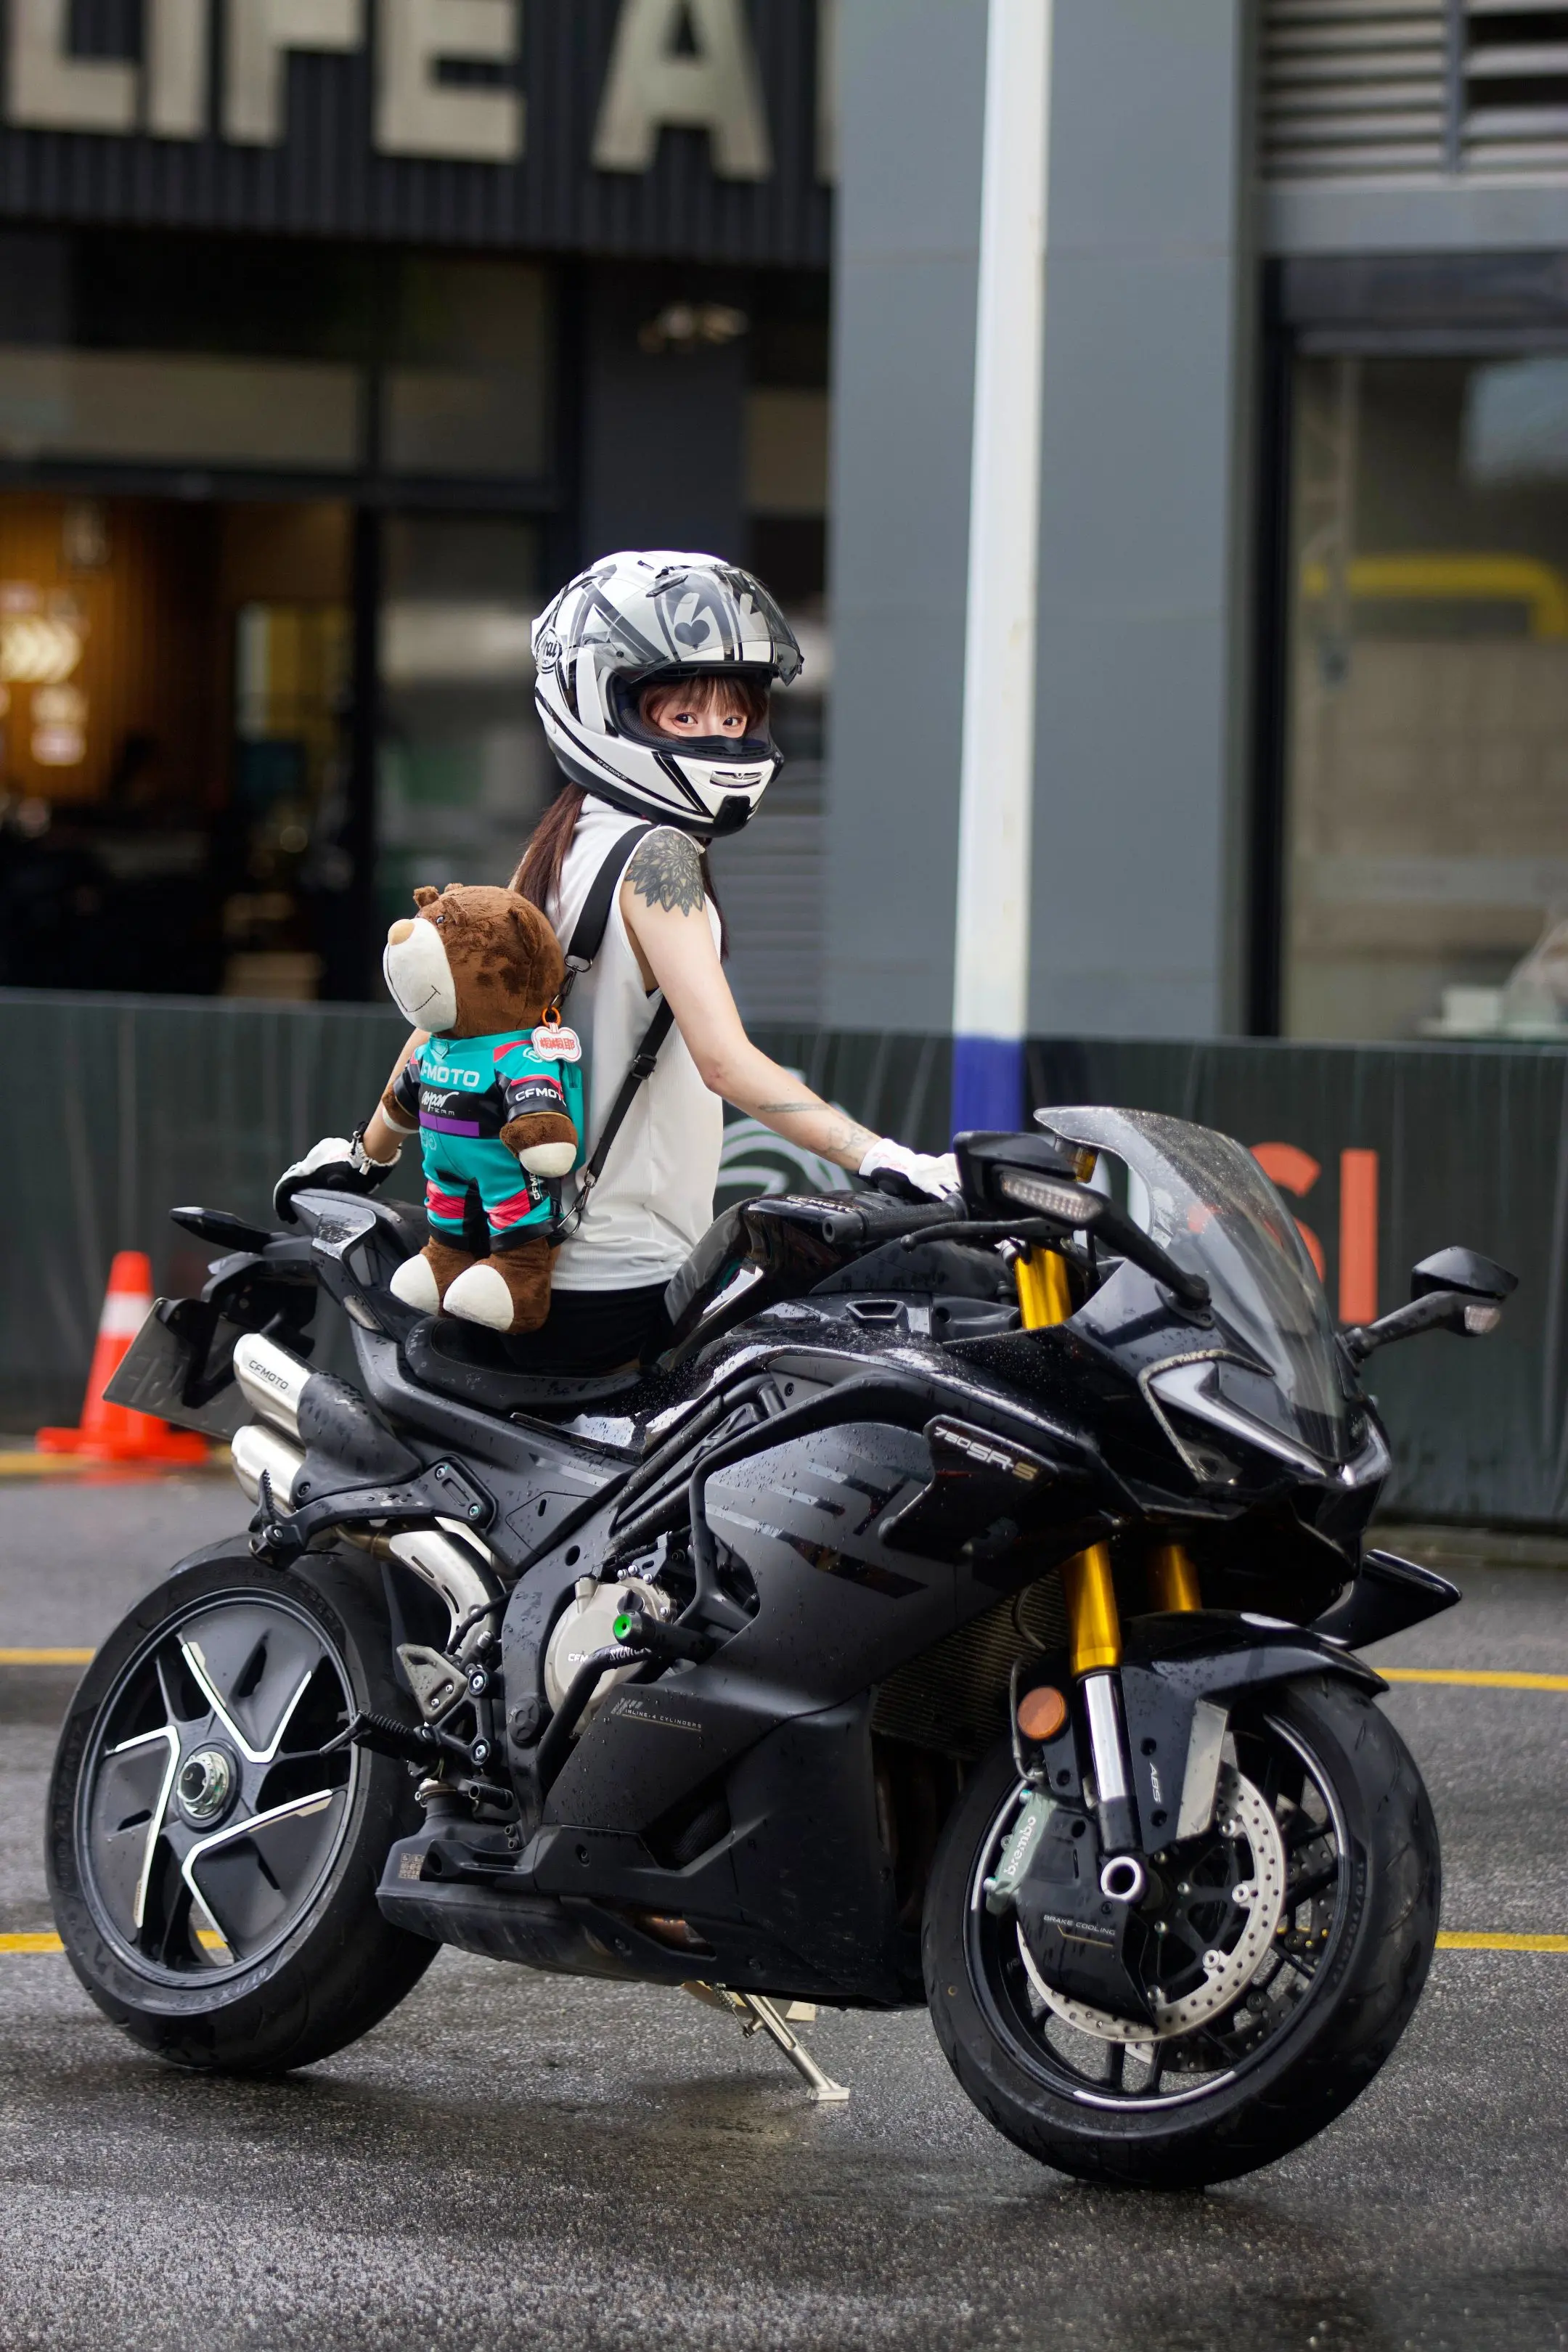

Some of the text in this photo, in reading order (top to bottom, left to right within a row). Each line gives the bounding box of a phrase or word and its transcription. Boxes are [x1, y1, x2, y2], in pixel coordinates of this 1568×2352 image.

[7, 0, 526, 163] LIFE
[515, 1087, 562, 1101] CFMOT
[249, 1360, 289, 1389] CFMOTO
[568, 1652, 589, 1662] CFM
[660, 1715, 702, 1728] CYLINDERS
[1149, 1762, 1161, 1803] ABS
[1003, 1816, 1037, 1876] brembo
[1043, 1914, 1116, 1935] BRAKE COOLING
